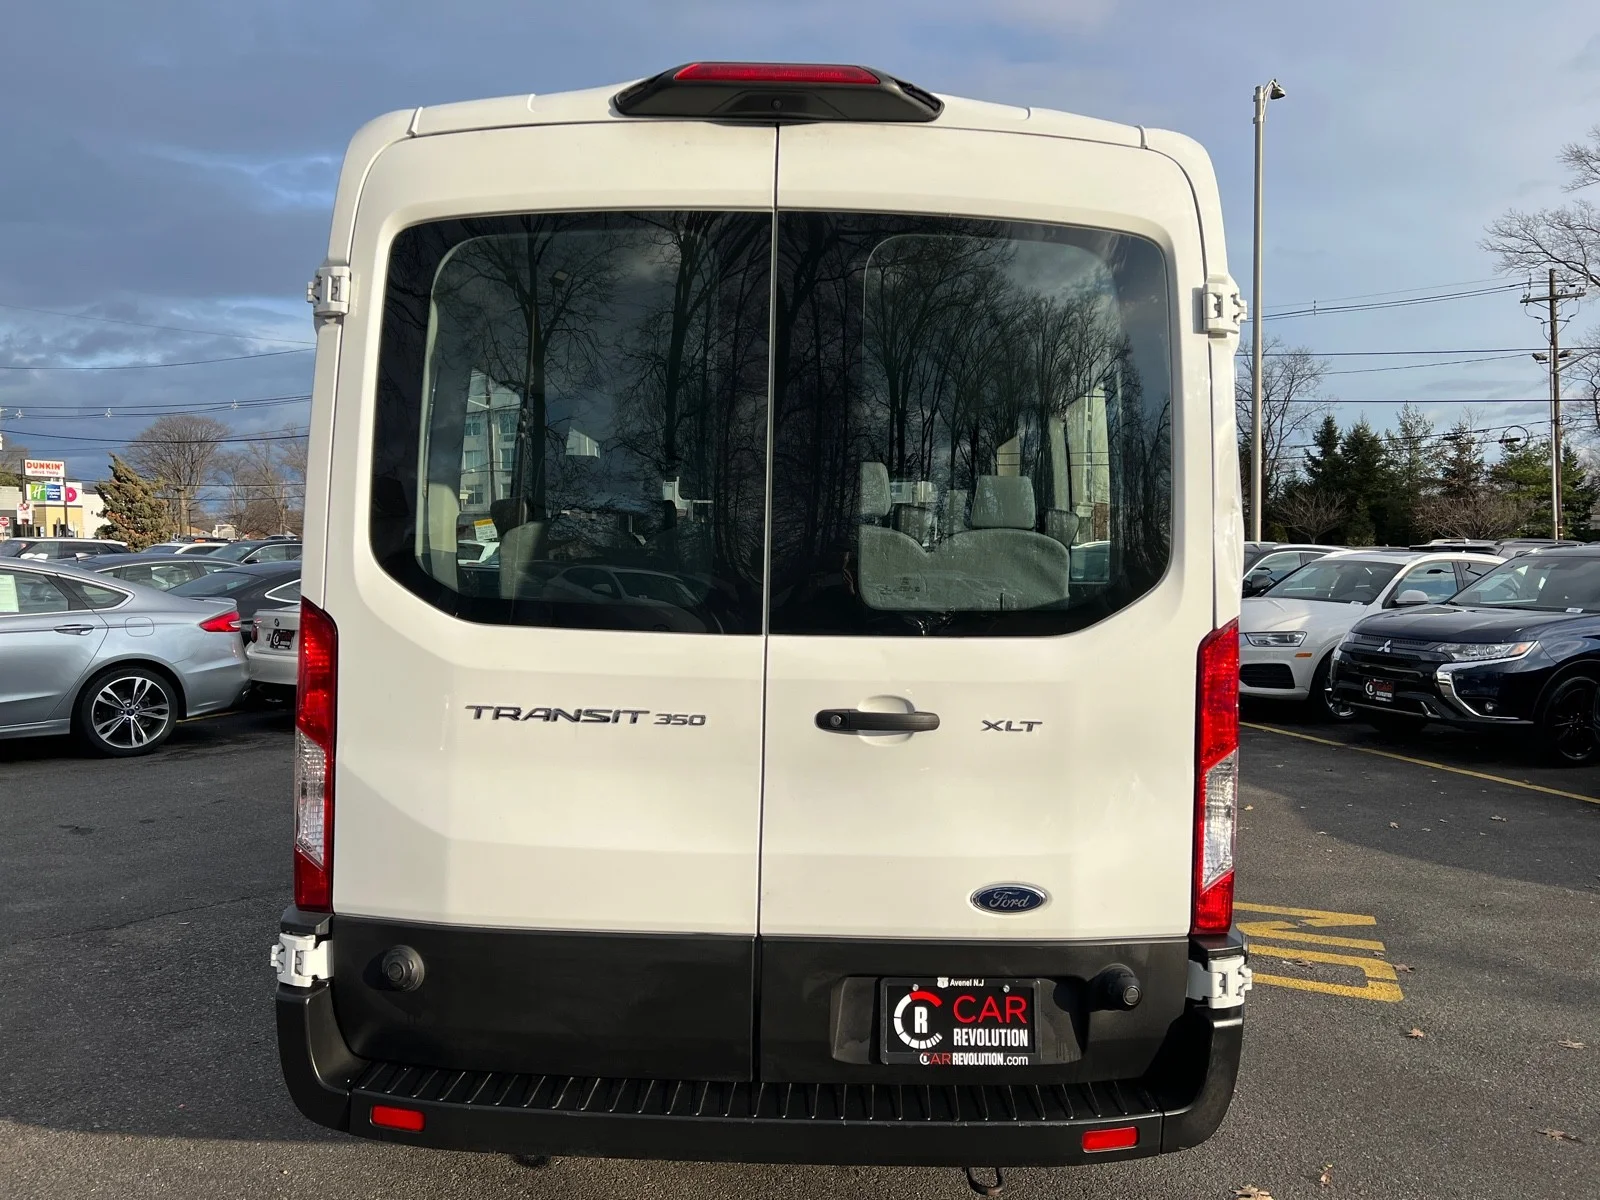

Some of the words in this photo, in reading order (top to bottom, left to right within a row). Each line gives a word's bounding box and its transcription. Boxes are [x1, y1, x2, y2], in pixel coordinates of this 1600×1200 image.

[26, 462, 63, 470] DUNKIN'
[465, 705, 650, 725] TRANSIT
[653, 713, 706, 726] 350
[981, 719, 1043, 733] XLT
[988, 890, 1030, 909] Ford
[950, 978, 972, 987] Avenel
[953, 995, 1028, 1024] CAR
[953, 1028, 1029, 1047] REVOLUTION
